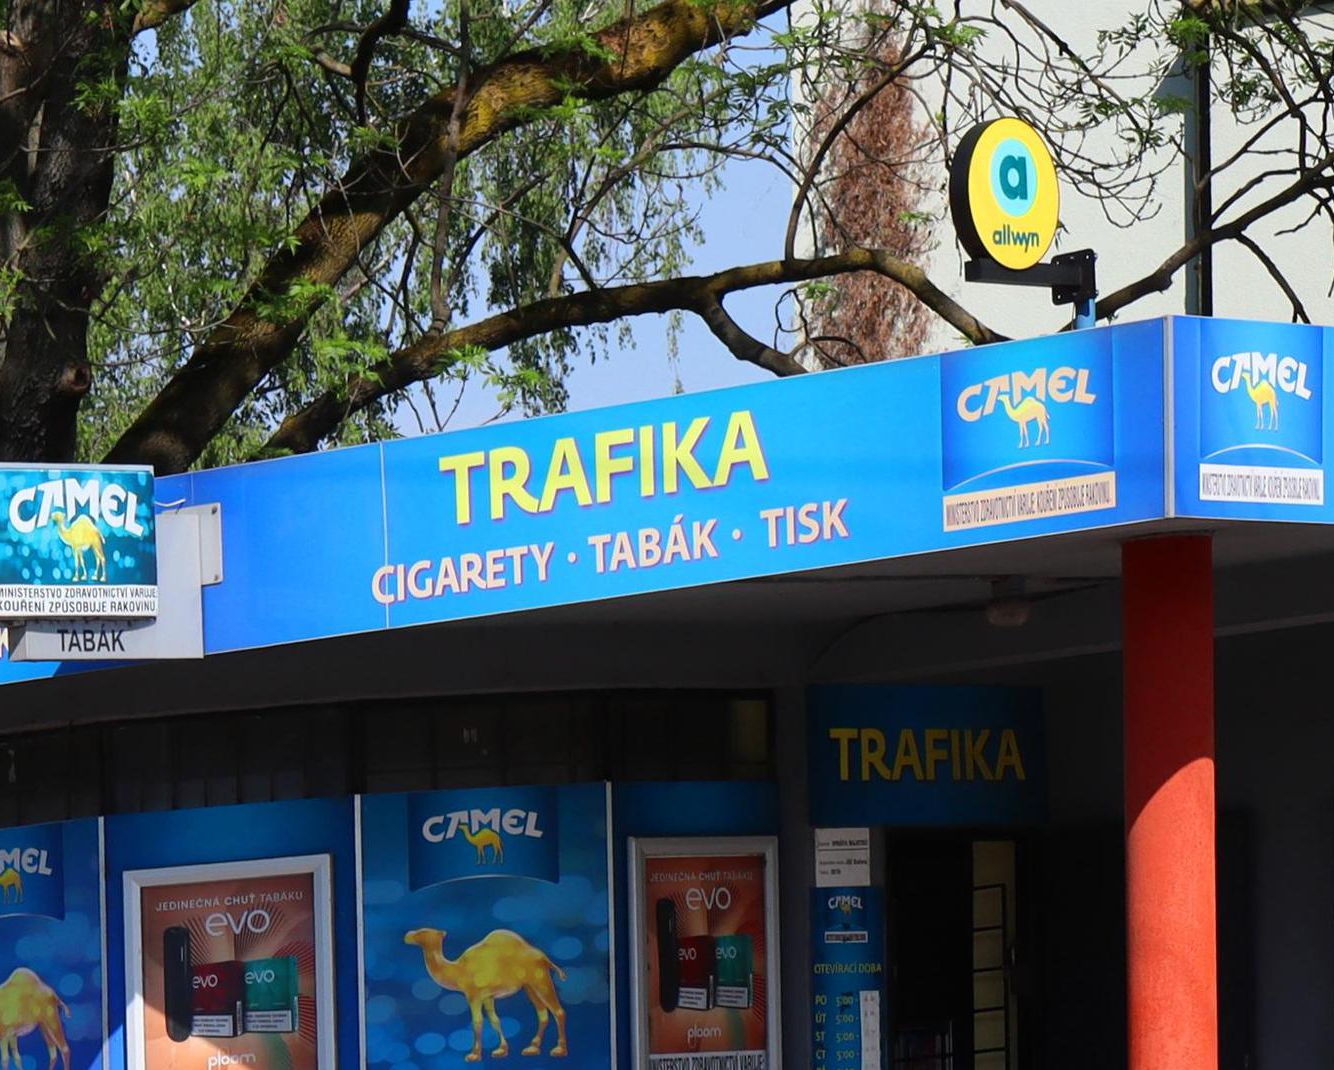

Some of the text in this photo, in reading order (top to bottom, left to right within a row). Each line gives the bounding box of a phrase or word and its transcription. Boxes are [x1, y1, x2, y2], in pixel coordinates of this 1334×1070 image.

[992, 224, 1040, 253] allwyn
[1211, 351, 1312, 401] CAMEL
[956, 366, 1097, 422] CAMEL
[438, 409, 770, 525] TRAFIKA
[8, 477, 145, 538] CAMEL
[370, 498, 850, 605] CIGARETY TABÁK TISK
[65, 587, 129, 599] ZDRAVOTNICTVÍ
[49, 599, 107, 613] ZPŮSOBUJE
[56, 623, 126, 652] TABÁK
[828, 727, 1027, 782] TRAFIKA
[421, 807, 544, 843] CAMEL
[155, 897, 220, 912] JEDINEČNÁ
[224, 893, 256, 905] CHUŤ
[685, 887, 732, 911] evo
[827, 895, 864, 910] CAMEL
[205, 909, 271, 937] evo
[678, 947, 697, 961] evo
[715, 946, 738, 960] evo
[244, 969, 275, 985] evo
[858, 963, 882, 974] DOBA
[192, 974, 219, 989] evo
[687, 1024, 722, 1047] ploom
